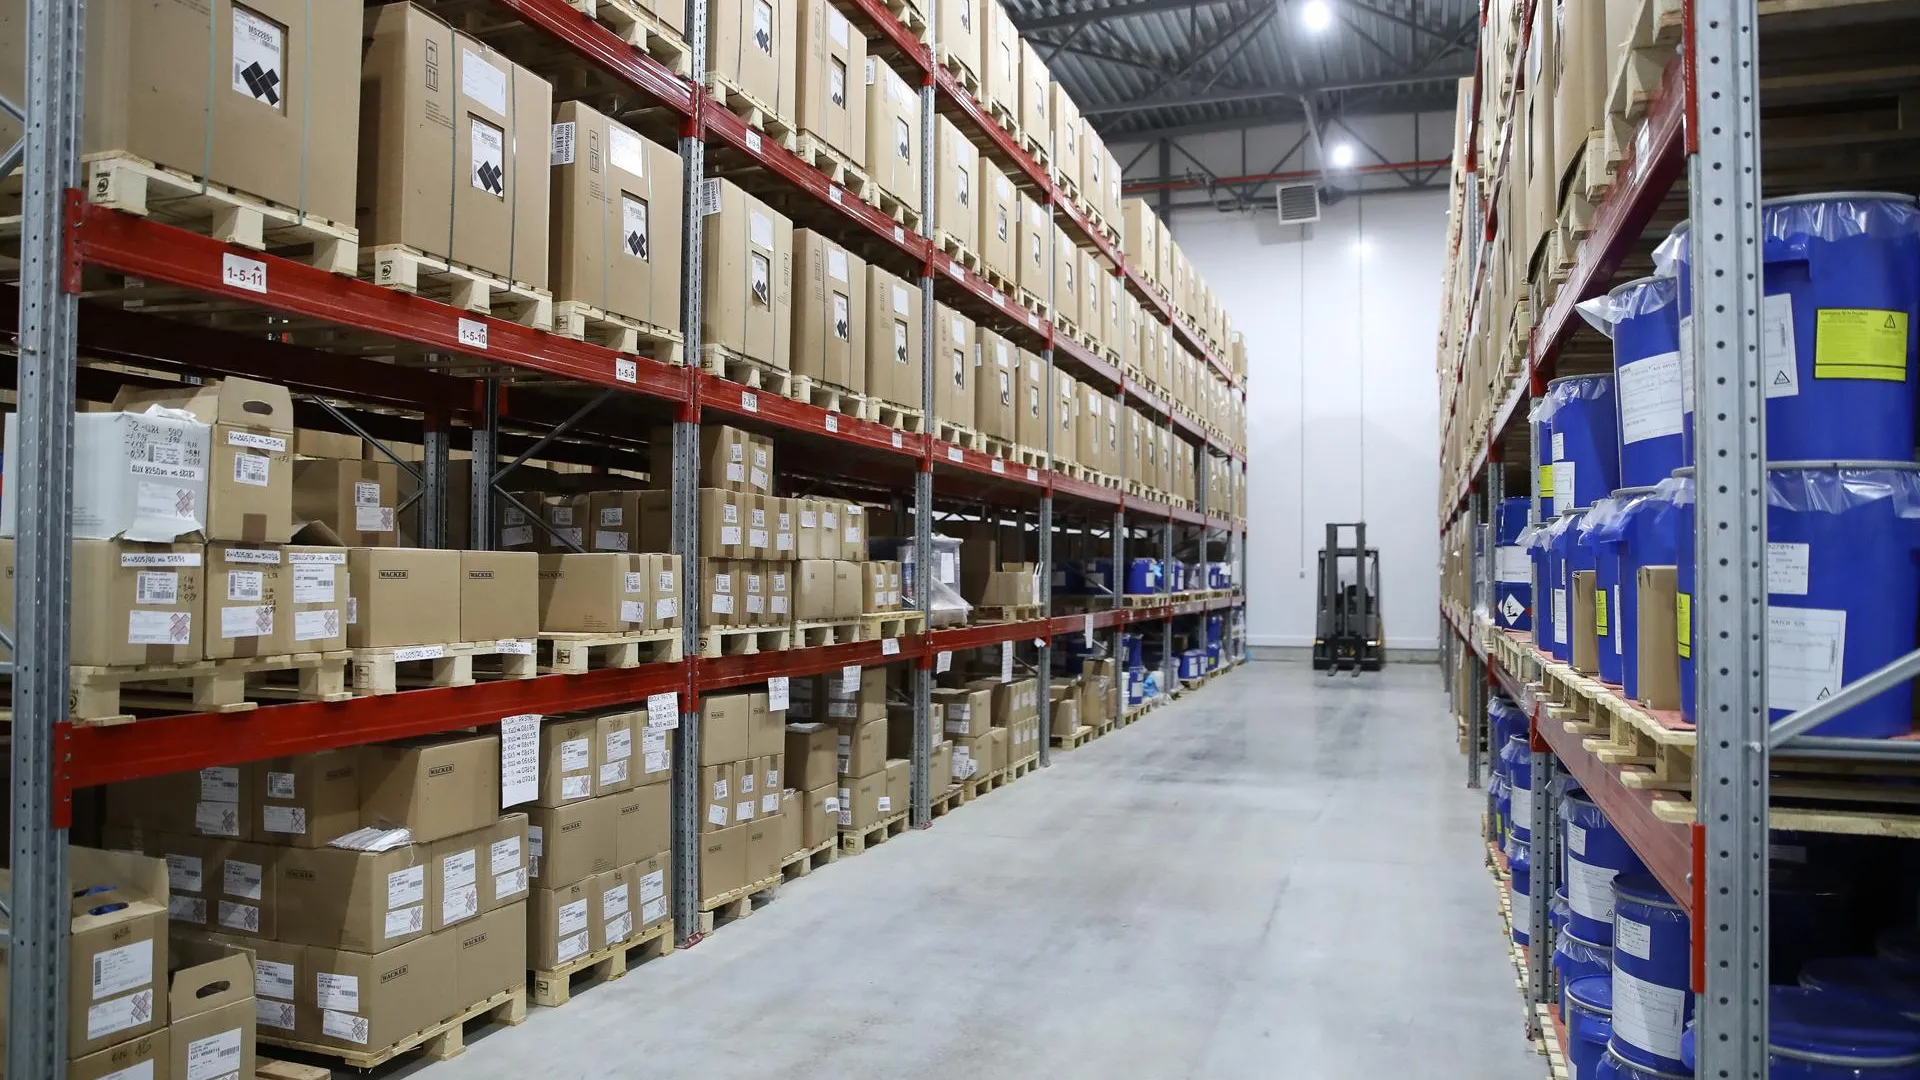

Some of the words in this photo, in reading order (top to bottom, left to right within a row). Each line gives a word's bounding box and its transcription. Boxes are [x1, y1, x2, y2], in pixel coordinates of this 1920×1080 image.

[227, 266, 262, 286] 1-5-11
[462, 329, 486, 344] 1-5-10
[618, 367, 635, 379] 1-5-9
[429, 765, 453, 775] WACKER
[464, 935, 485, 947] WACKER
[382, 967, 407, 981] WACKER
